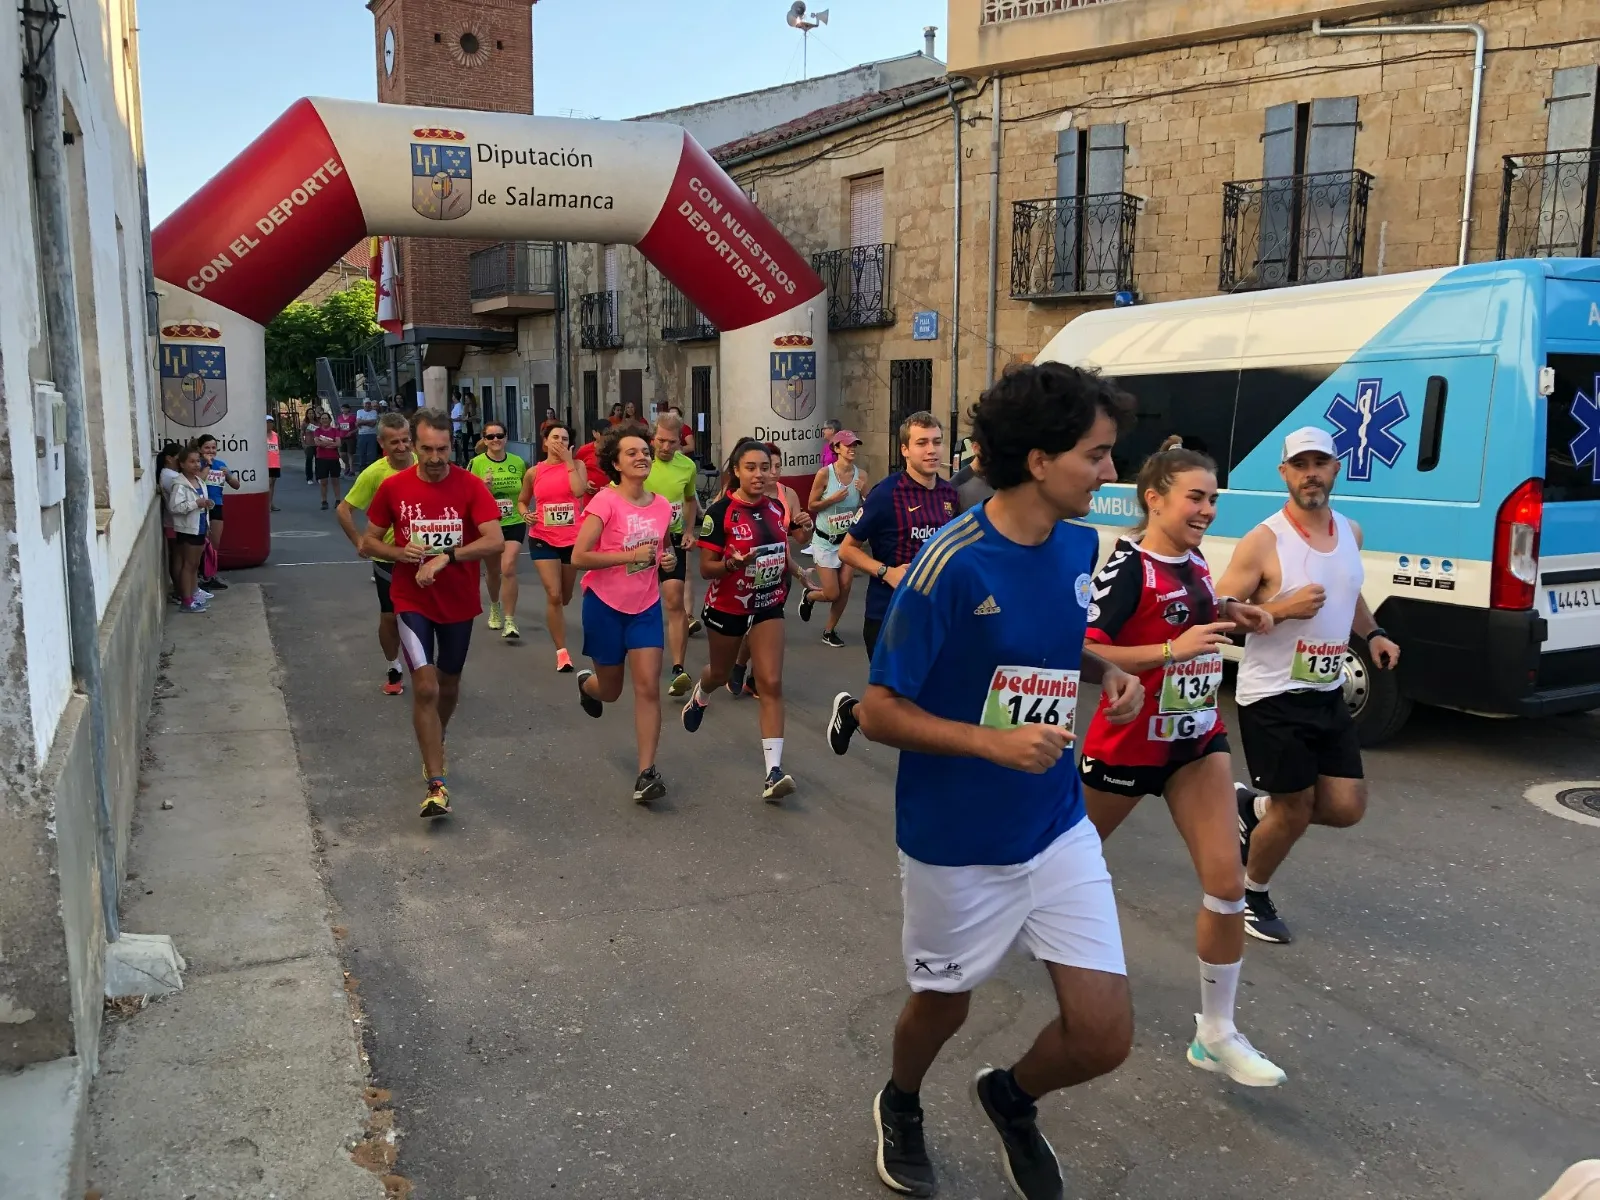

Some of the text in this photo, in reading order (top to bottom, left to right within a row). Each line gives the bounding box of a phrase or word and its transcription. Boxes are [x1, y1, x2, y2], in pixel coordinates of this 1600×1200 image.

[477, 143, 593, 169] Diputación
[477, 186, 614, 210] de Salamanca
[187, 157, 343, 293] CON EL DEPORTE
[688, 177, 797, 295] CON NUESTROS
[677, 200, 776, 305] DEPORTISTAS
[550, 511, 569, 521] 157
[411, 522, 462, 533] bedunia
[422, 532, 453, 547] 126
[757, 556, 785, 569] bedunia
[760, 566, 780, 580] 133
[1559, 590, 1589, 609] 4443
[973, 606, 1002, 615] adidas
[1307, 655, 1341, 674] 135
[991, 671, 1077, 698] bedunia
[1177, 675, 1211, 699] 136
[1008, 695, 1060, 726] 146
